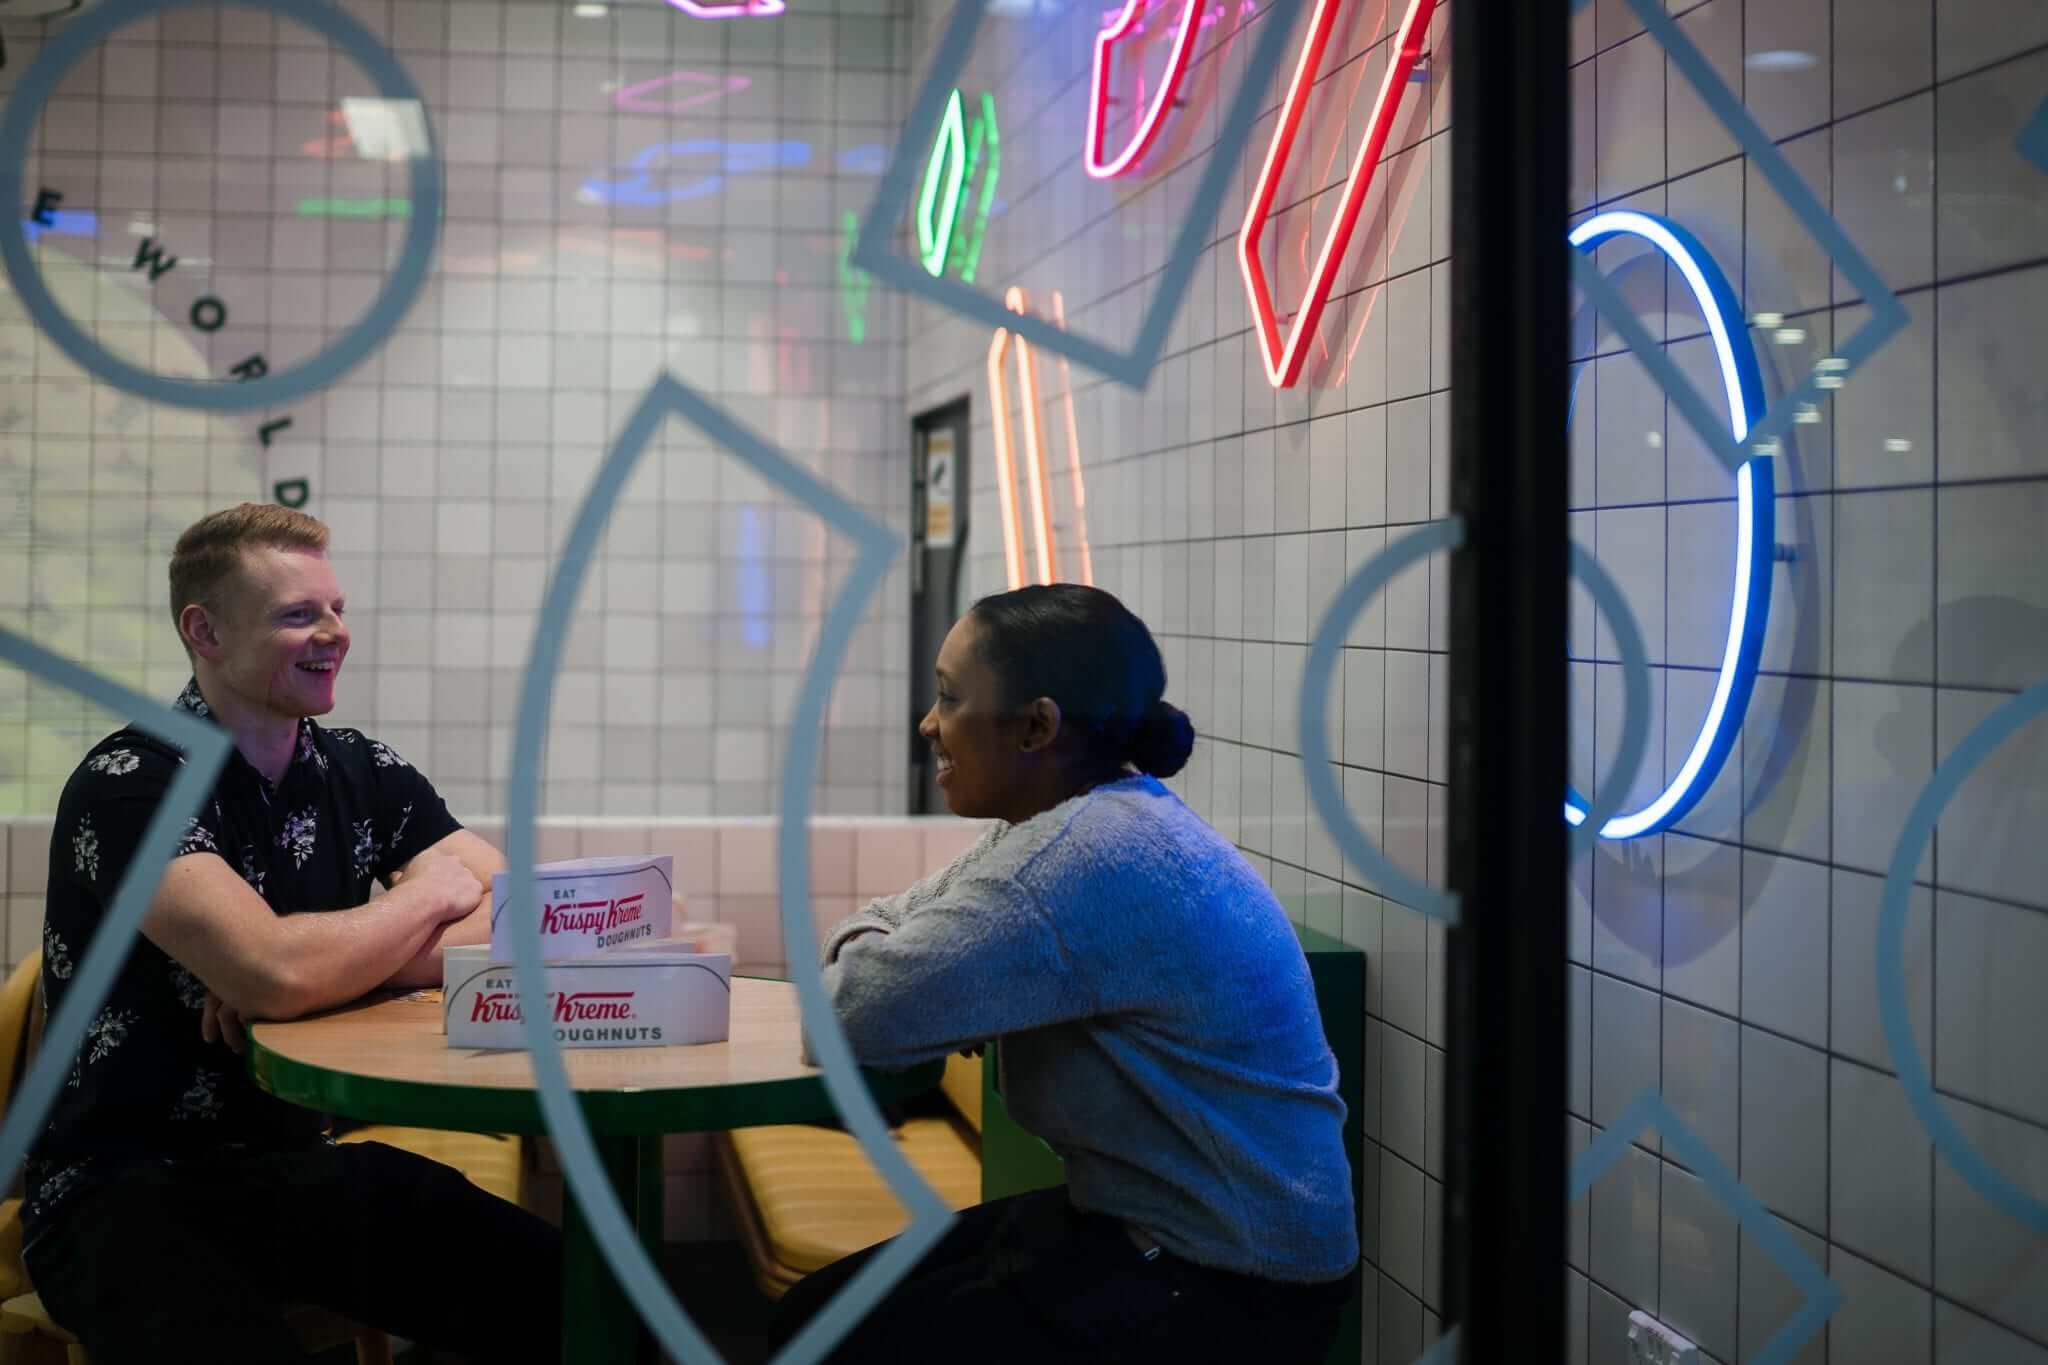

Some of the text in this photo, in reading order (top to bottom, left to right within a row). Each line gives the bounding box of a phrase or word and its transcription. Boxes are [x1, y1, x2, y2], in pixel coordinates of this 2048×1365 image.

[131, 236, 310, 509] WORLD
[553, 888, 577, 900] EAT
[539, 893, 645, 936] Krispy Kreme
[597, 923, 652, 949] DOUGHNUTS
[485, 978, 513, 990] EAT
[470, 991, 555, 1025] Kris
[553, 1026, 663, 1042] OUGHNUTS
